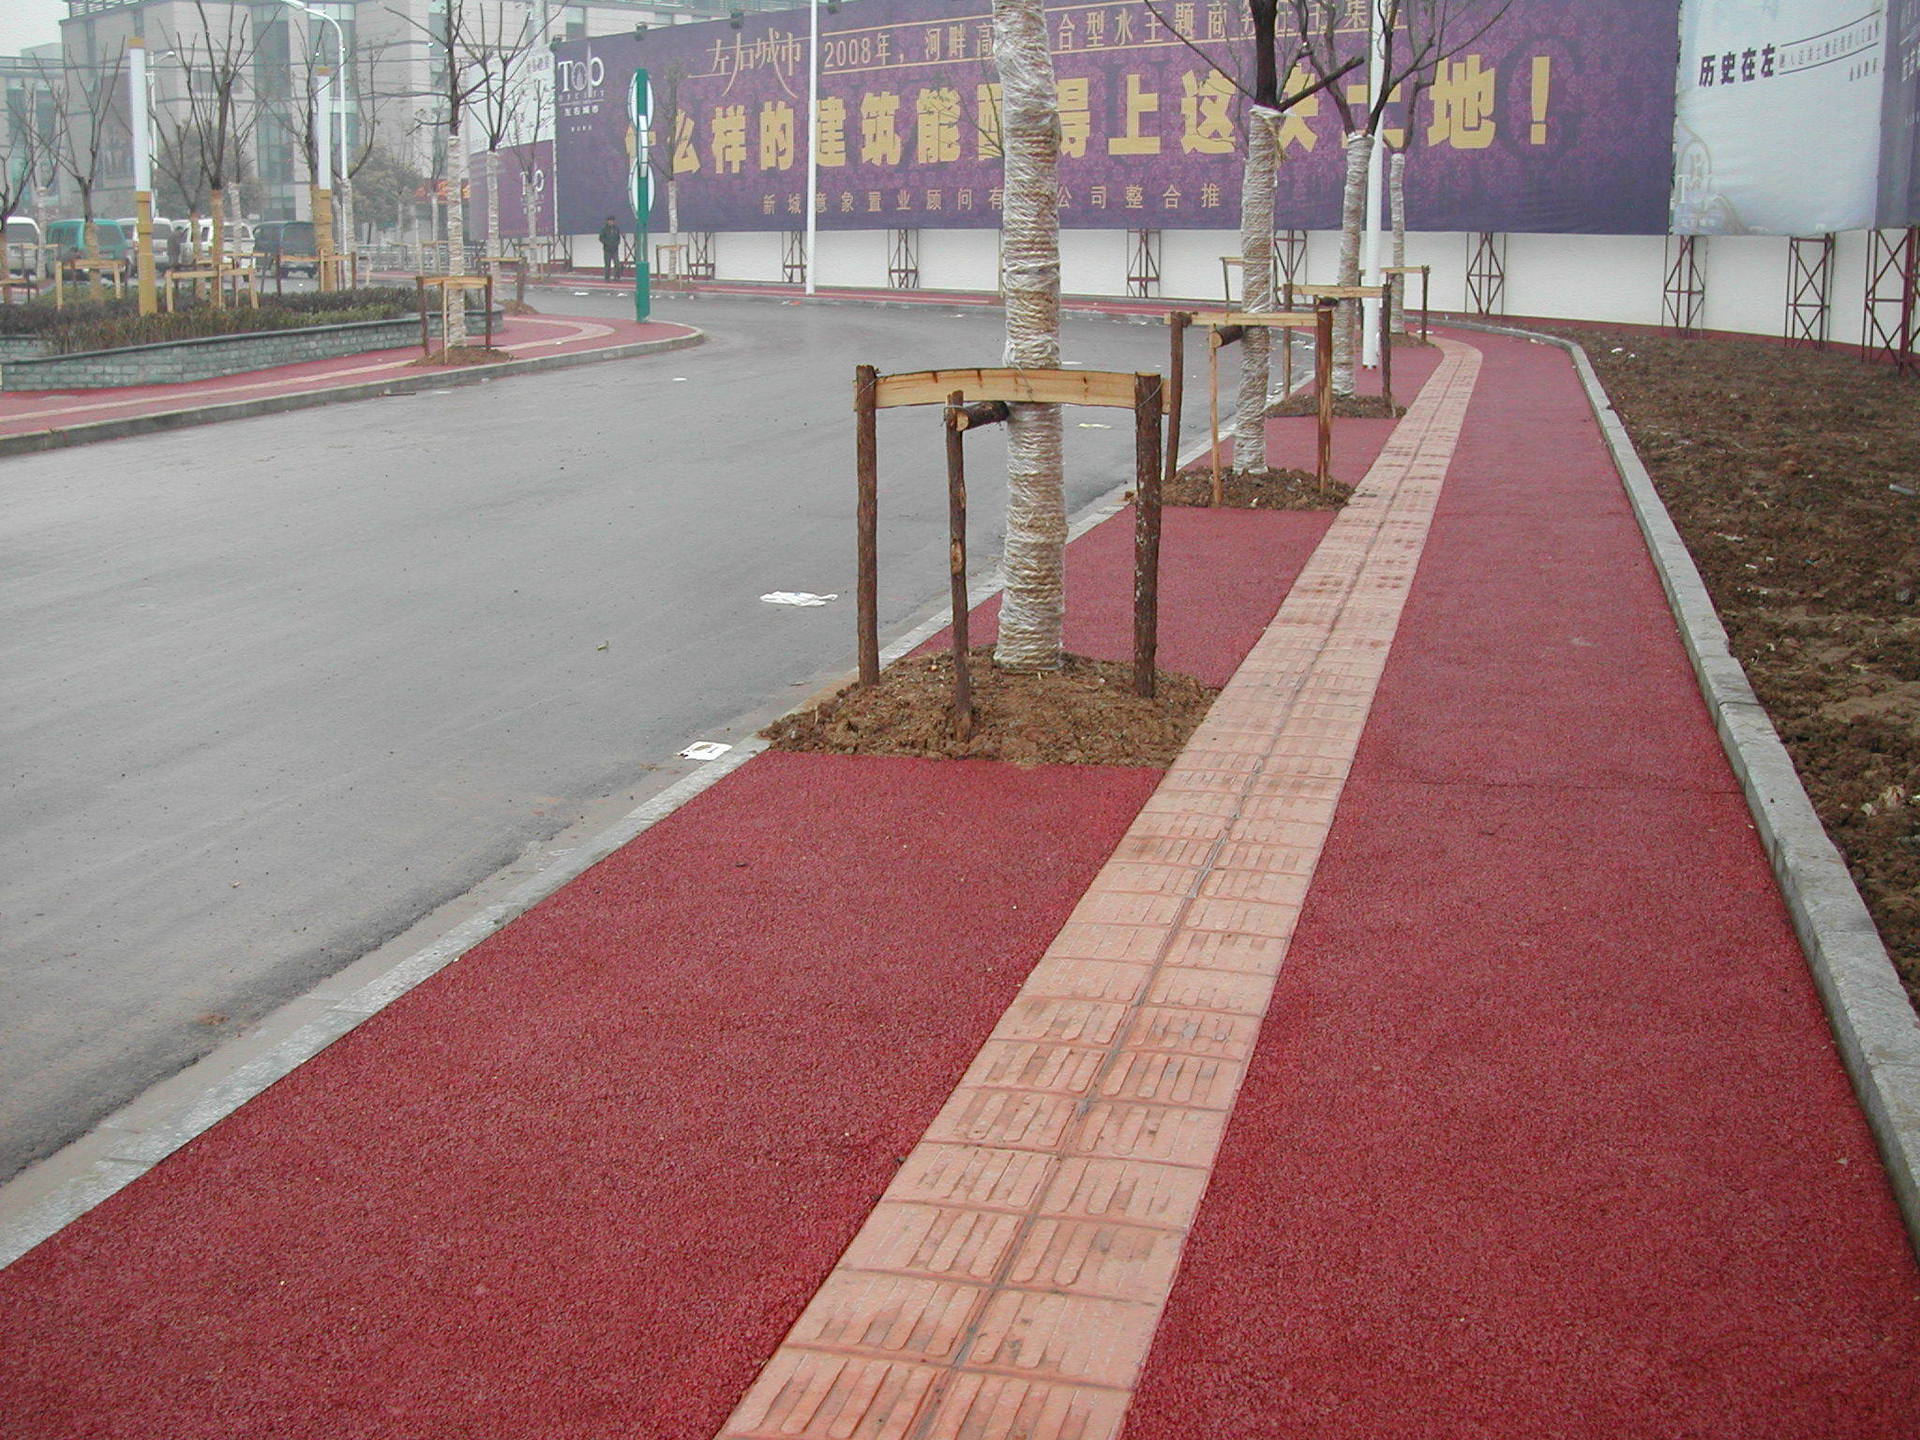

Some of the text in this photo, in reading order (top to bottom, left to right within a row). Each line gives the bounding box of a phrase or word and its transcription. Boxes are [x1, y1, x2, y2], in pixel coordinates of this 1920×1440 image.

[704, 27, 801, 98] 左右城市
[1699, 43, 1775, 87] 历史在左
